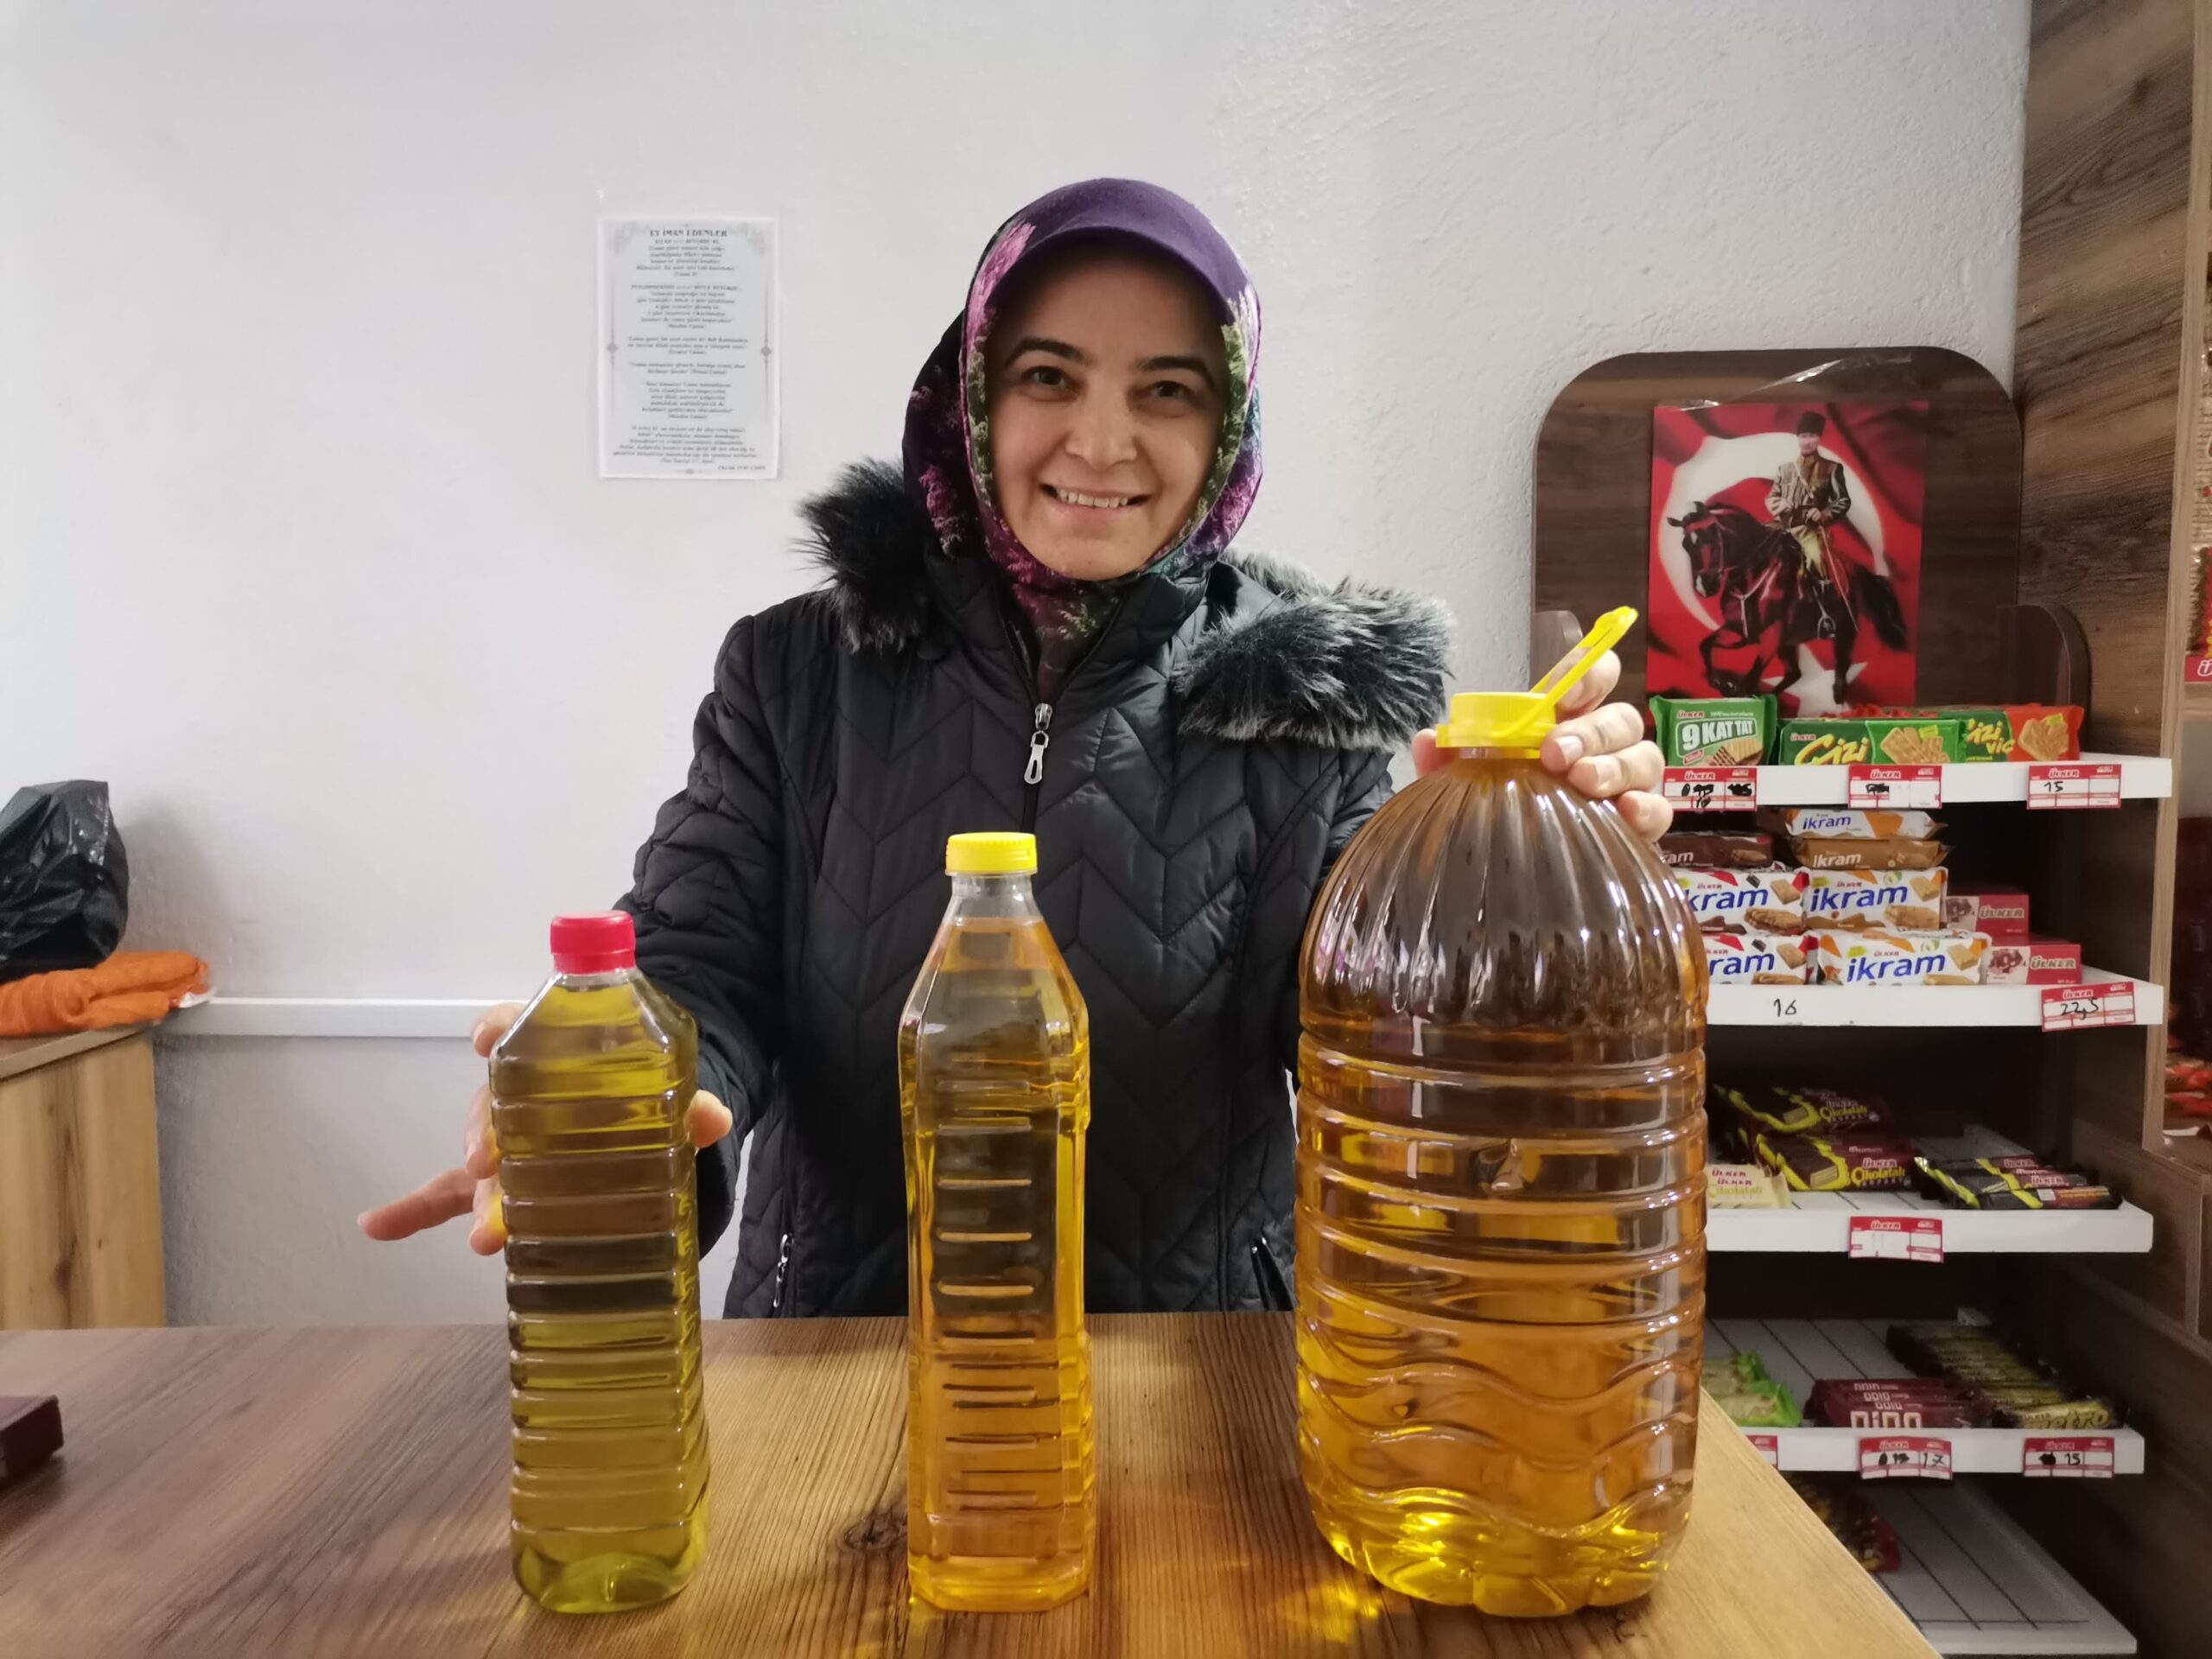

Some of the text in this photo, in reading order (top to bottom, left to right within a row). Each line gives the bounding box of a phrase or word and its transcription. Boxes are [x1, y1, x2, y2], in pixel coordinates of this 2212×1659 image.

[1678, 710, 1705, 719] ÜLKER
[1681, 720, 1753, 751] 9 KAT TAT
[1685, 770, 1715, 780] ÜLKER
[1870, 768, 1901, 779] ÜLKER
[2049, 767, 2079, 778] ÜLKER
[2044, 780, 2064, 793] 15
[1802, 816, 1852, 830] ikram
[1809, 886, 1908, 912] ikram
[1979, 905, 2024, 918] ÜLKER
[1847, 954, 1947, 982] ikram
[2031, 955, 2076, 969] ÜLKER
[2063, 988, 2094, 1000] ÜLKER
[1773, 998, 1797, 1017] 16
[1862, 1157, 1897, 1168] ÜLKER
[1712, 1168, 1746, 1177] ÜLKER
[1717, 1177, 1752, 1186] ÜLKER
[1871, 1219, 1901, 1230] ÜLKER
[2063, 1452, 2081, 1466] 15
